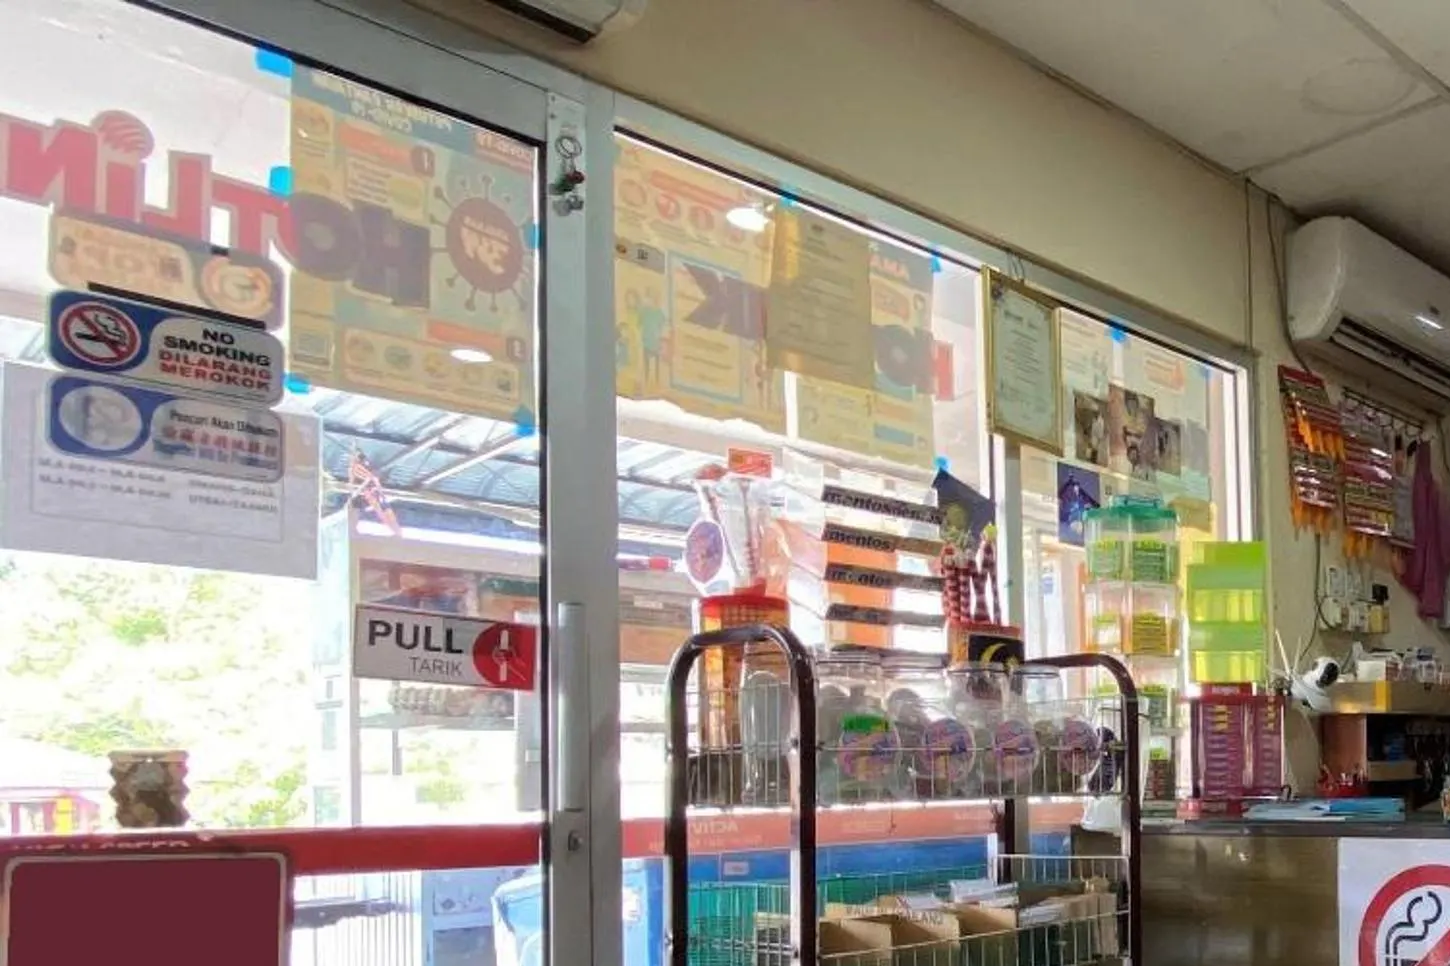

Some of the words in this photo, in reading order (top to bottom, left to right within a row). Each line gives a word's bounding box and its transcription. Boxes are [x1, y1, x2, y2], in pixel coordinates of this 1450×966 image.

[163, 335, 271, 367] SMOKING
[202, 327, 234, 345] NO
[159, 350, 272, 380] DILARANG
[160, 362, 270, 393] MEROKOK
[829, 529, 891, 550] mentos
[368, 619, 464, 655] PULL
[409, 656, 464, 676] TARIK
